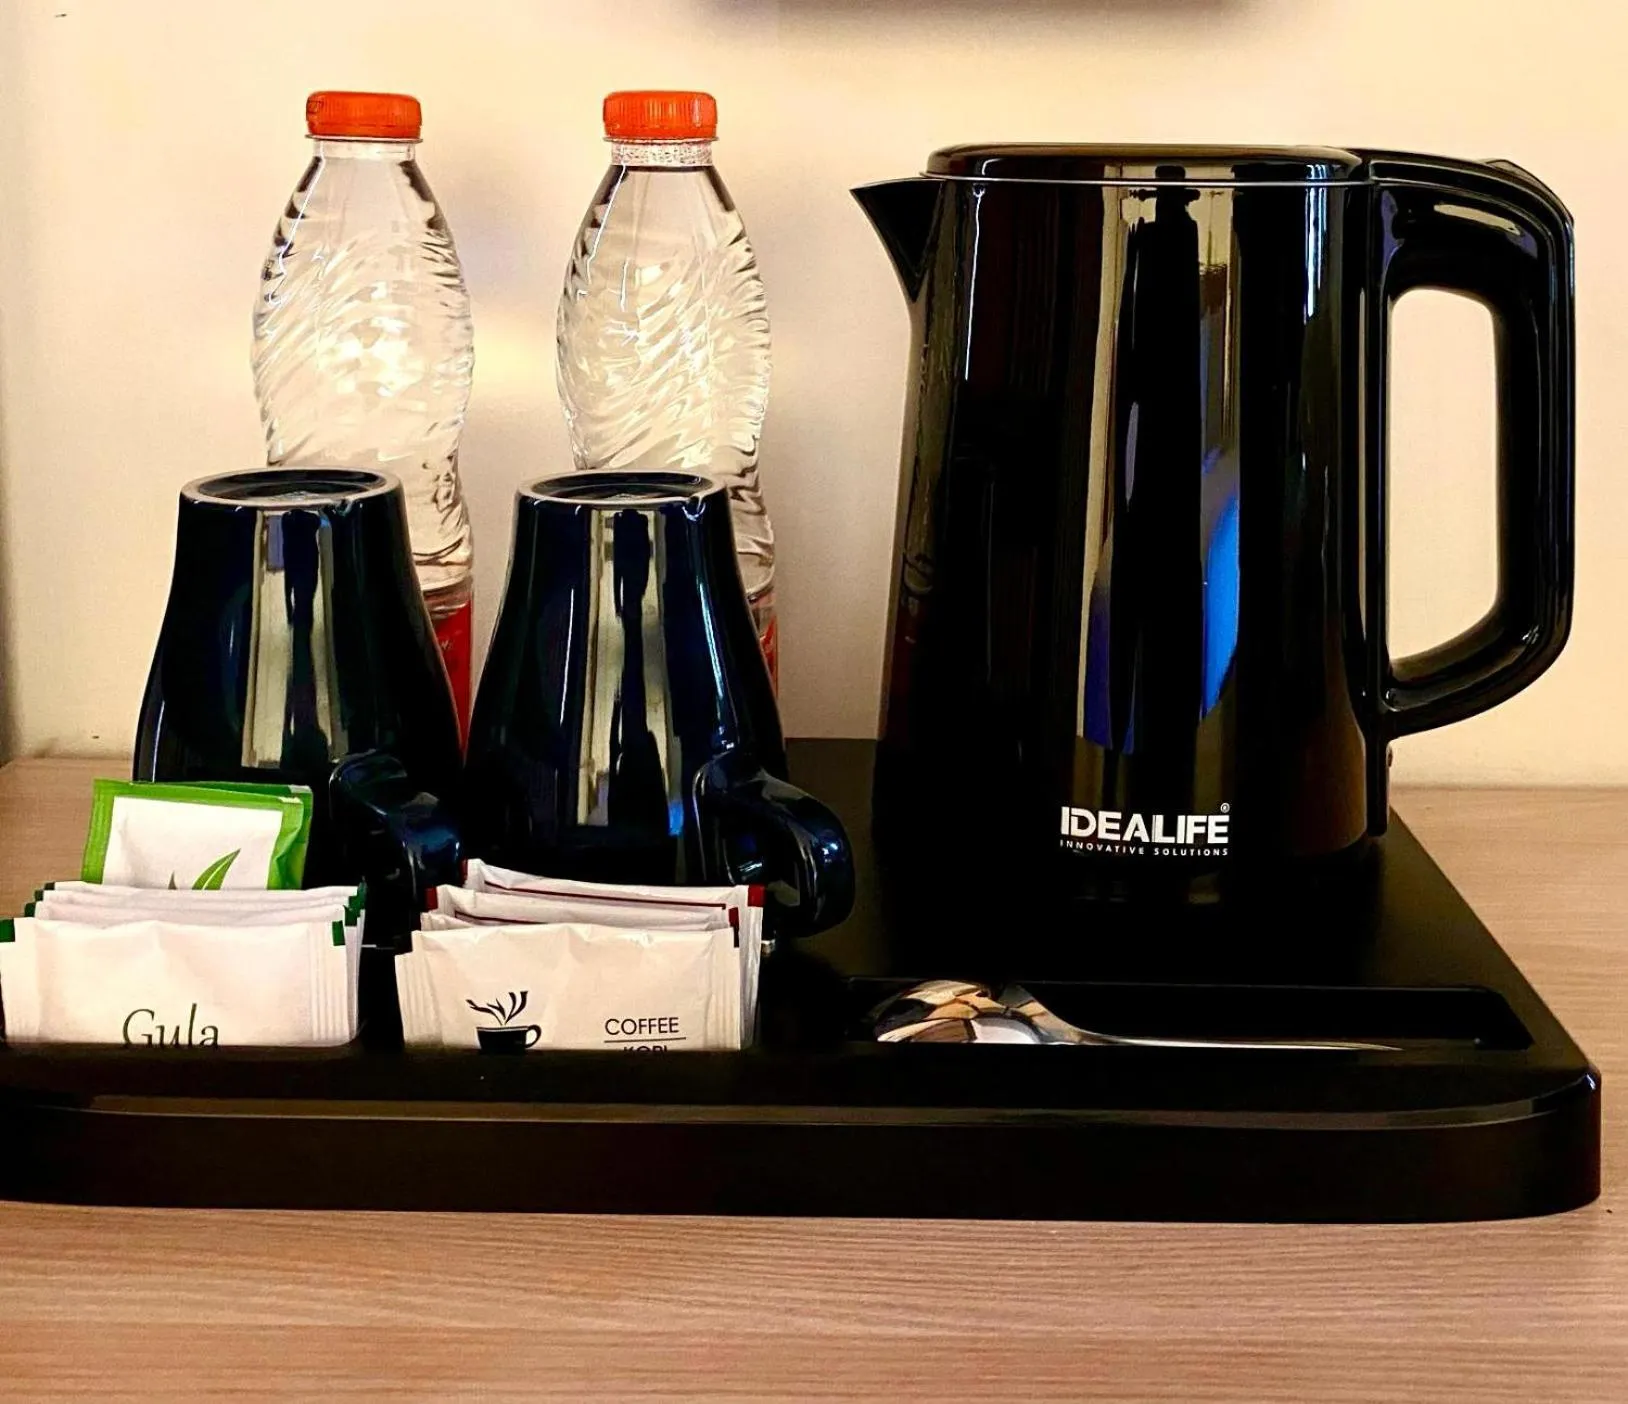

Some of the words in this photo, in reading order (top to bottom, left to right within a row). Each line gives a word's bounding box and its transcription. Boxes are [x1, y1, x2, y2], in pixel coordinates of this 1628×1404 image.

[1060, 839, 1145, 855] INNOVATIVE
[1153, 847, 1229, 857] SOLUTIONS
[122, 1002, 219, 1047] Gula
[605, 1017, 680, 1035] COFFEE
